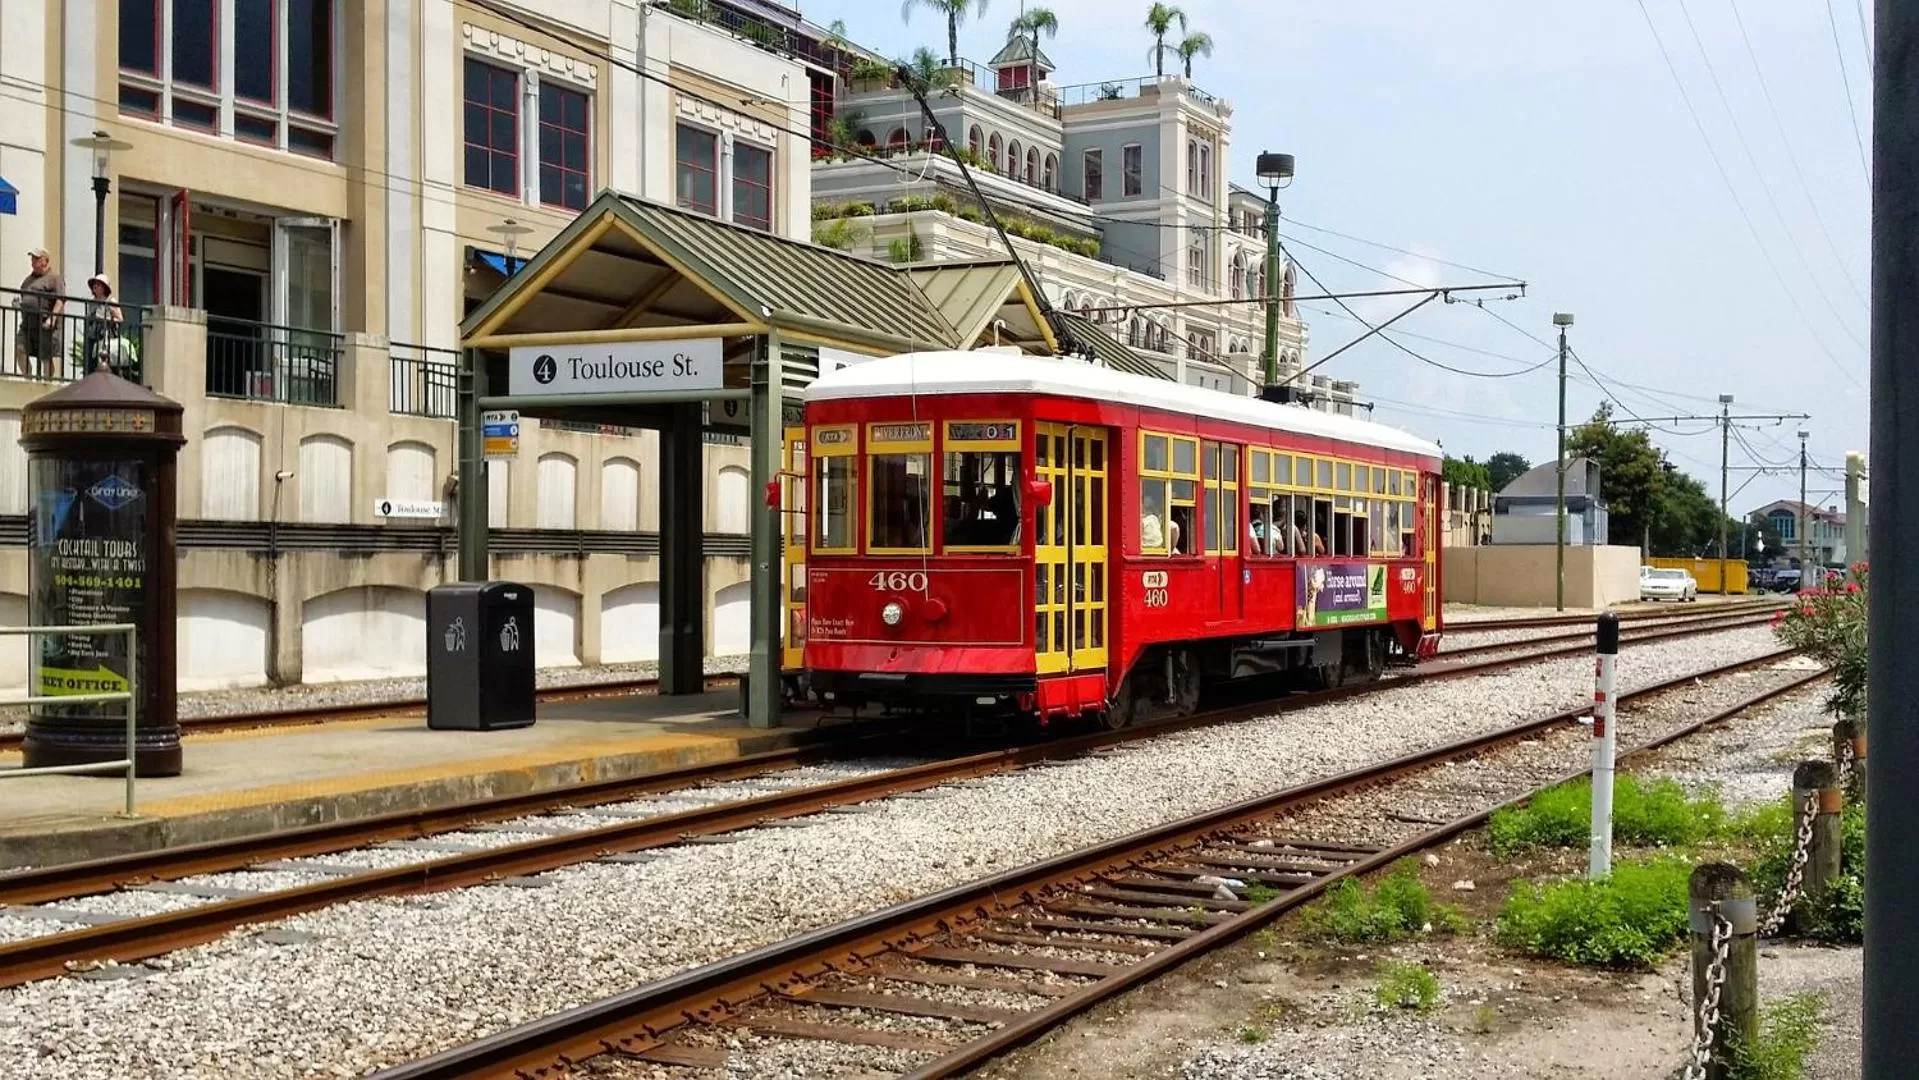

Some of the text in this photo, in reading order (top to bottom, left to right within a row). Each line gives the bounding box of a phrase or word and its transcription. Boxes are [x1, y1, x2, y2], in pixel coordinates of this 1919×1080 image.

[535, 353, 698, 383] 4 Toulouse St.
[873, 425, 929, 441] RIVERFRONT
[59, 539, 138, 558] COCKTAIL TOURS
[868, 571, 928, 591] 460
[1326, 570, 1344, 588] Horse
[1143, 589, 1168, 607] 460
[66, 677, 122, 691] OFFICE
